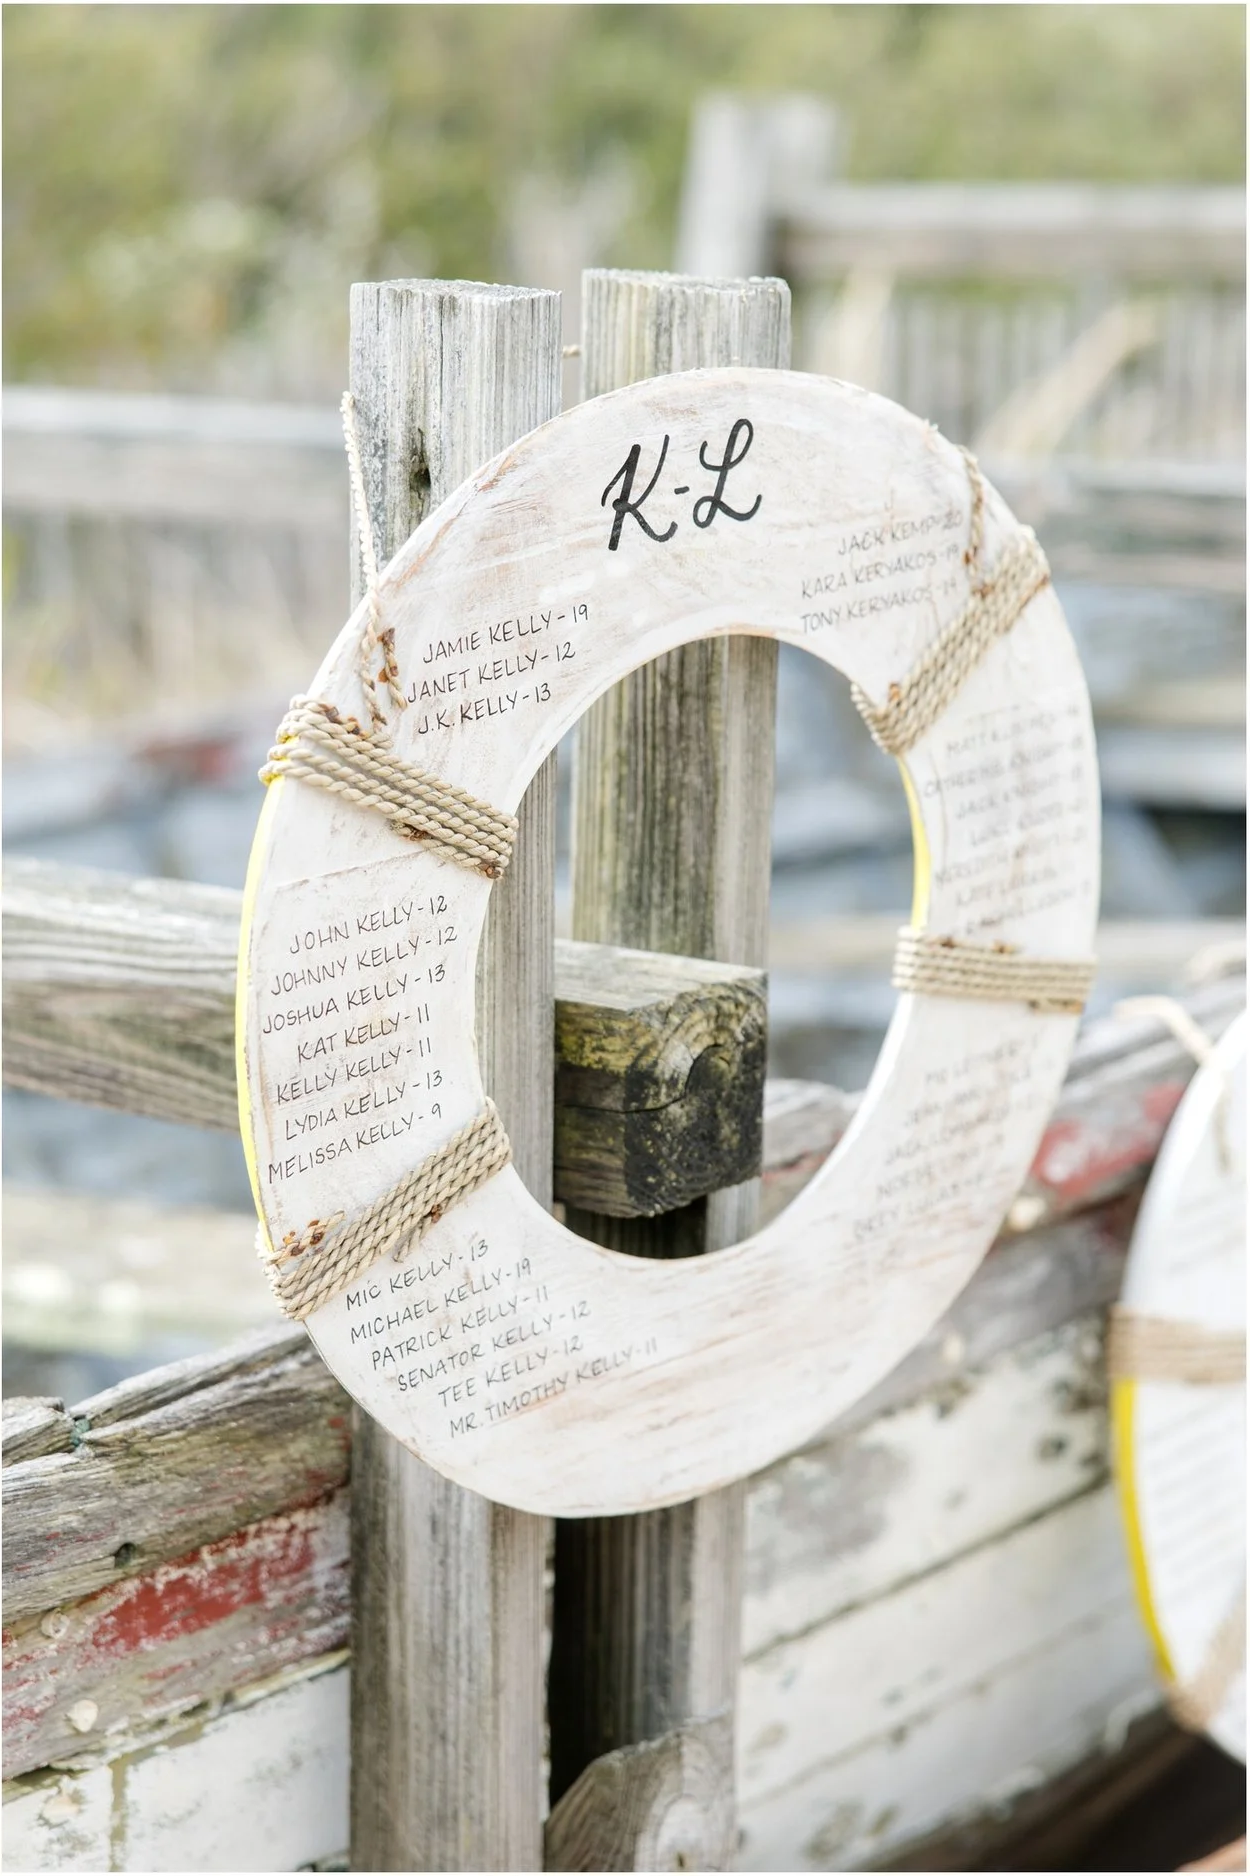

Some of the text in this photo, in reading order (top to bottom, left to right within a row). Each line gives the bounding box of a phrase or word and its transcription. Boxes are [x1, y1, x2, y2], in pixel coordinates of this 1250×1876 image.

[838, 527, 886, 556] JACK
[800, 605, 842, 634] TONY
[801, 572, 848, 599] KARA
[423, 631, 481, 664] JAMIE
[573, 604, 589, 623] 19
[407, 668, 471, 703] JANET
[556, 642, 576, 662] 12
[418, 708, 455, 734] J.K.
[535, 682, 551, 703] 13
[290, 921, 350, 954] JOHN
[429, 895, 448, 915] 12
[271, 956, 348, 996] JOHNNY
[438, 926, 458, 946] 12
[263, 998, 340, 1034] JOSHUA
[428, 963, 446, 984] 13
[298, 1032, 338, 1063] KAT
[417, 1003, 430, 1024] 11
[418, 1037, 431, 1057] 11
[285, 1107, 338, 1141] LYDIA
[427, 1069, 443, 1090] 13
[268, 1138, 353, 1184] MELISSA
[431, 1102, 442, 1120] 9
[346, 1285, 382, 1311] MIC
[470, 1238, 490, 1262] 13
[350, 1299, 440, 1344] MICHAEL
[516, 1257, 532, 1280] 19
[371, 1326, 451, 1371] PATRICK
[536, 1285, 550, 1304] 11
[397, 1343, 485, 1392] SENATOR
[571, 1300, 592, 1321] 12
[438, 1377, 476, 1408] TEE
[563, 1335, 585, 1358] 12
[450, 1412, 484, 1439] MR.
[485, 1376, 569, 1423] TIMOTHY
[645, 1337, 658, 1358] 11
